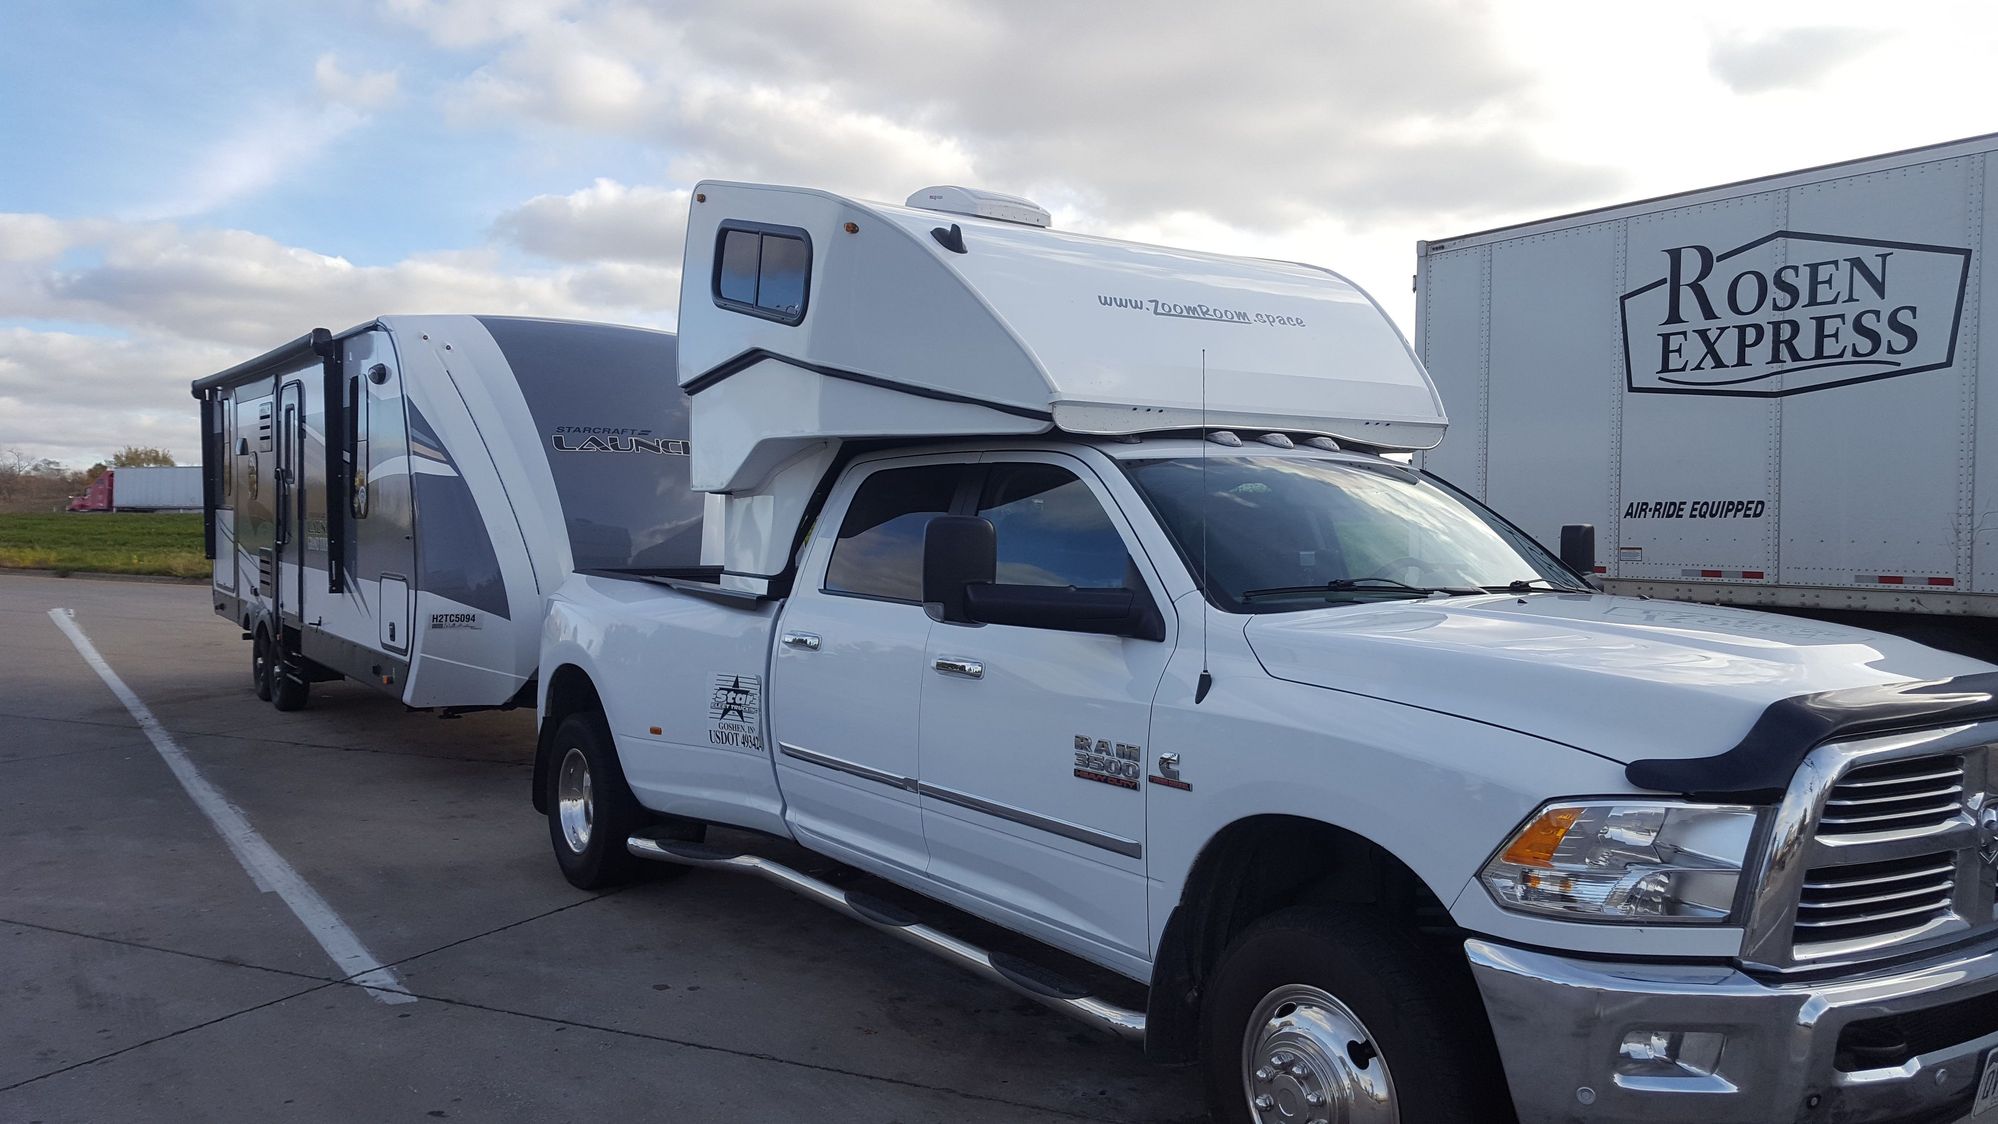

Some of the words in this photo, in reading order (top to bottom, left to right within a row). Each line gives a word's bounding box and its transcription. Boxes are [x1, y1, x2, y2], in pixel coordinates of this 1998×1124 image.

[1656, 305, 1919, 375] EXPRESS
[556, 426, 639, 436] STARCRAFT
[1624, 501, 1687, 519] AIR-RIDE
[1689, 500, 1765, 519] EQUIPPED
[432, 614, 476, 623] H2TC5094
[709, 730, 739, 746] USDOT
[1074, 735, 1140, 762] RAM
[1074, 751, 1140, 780] 3500
